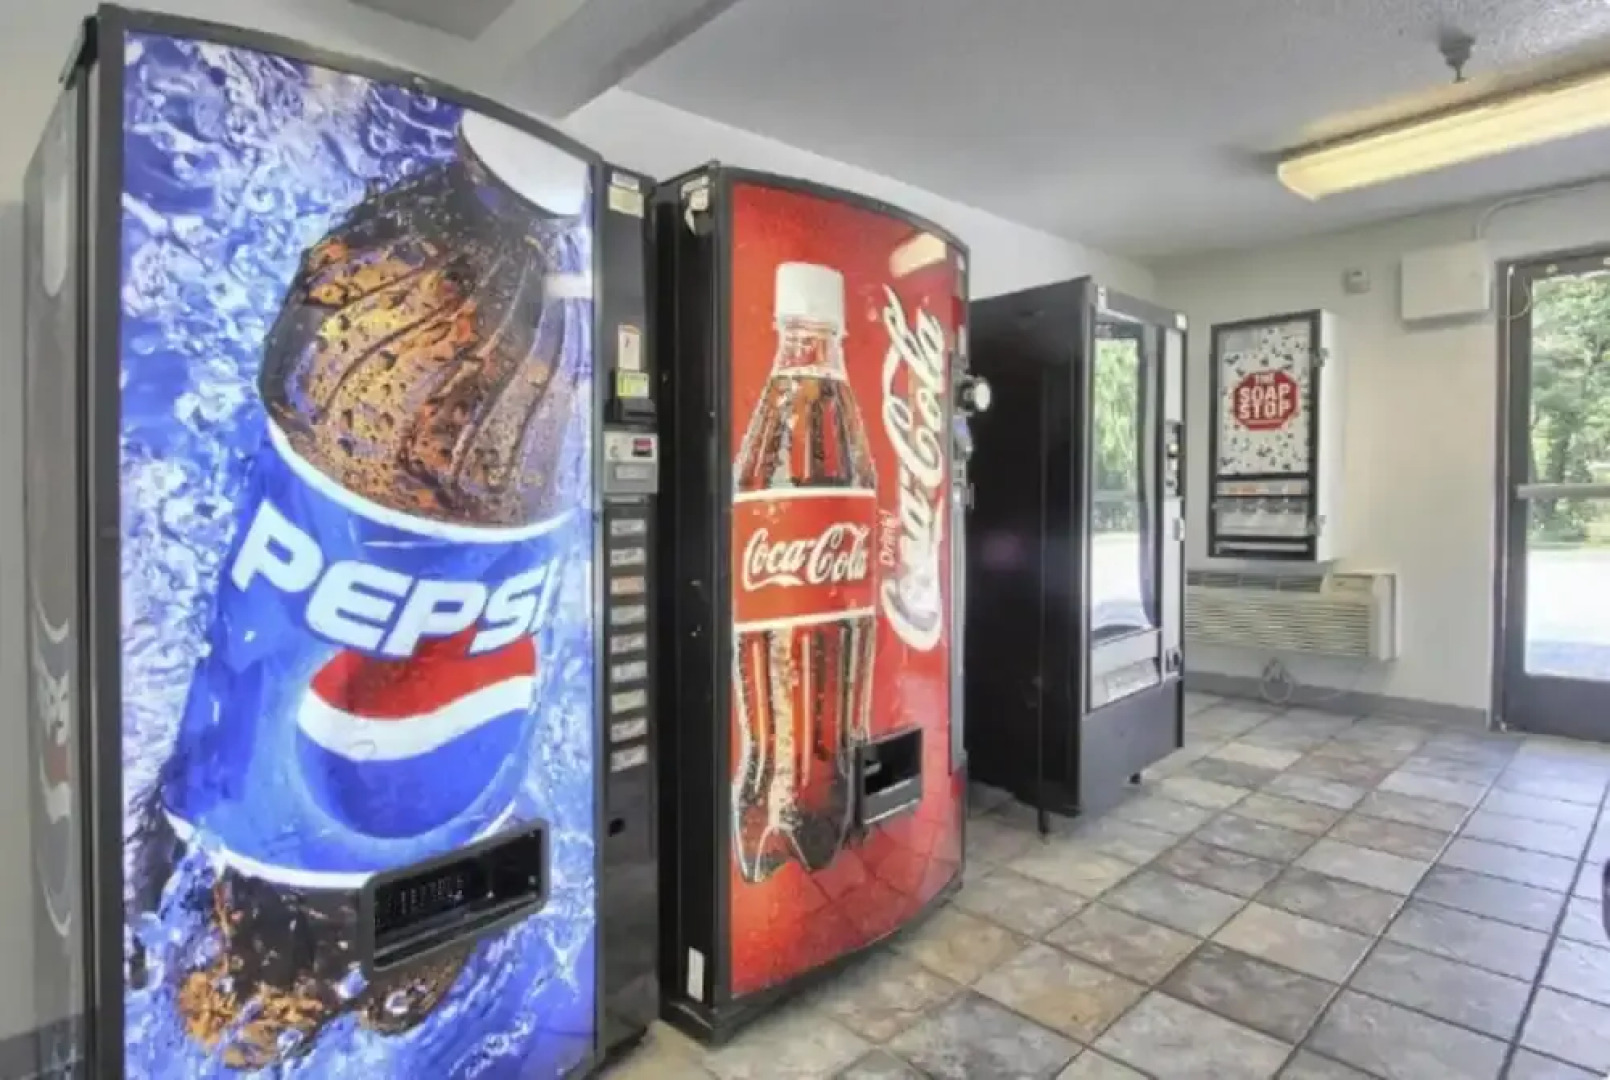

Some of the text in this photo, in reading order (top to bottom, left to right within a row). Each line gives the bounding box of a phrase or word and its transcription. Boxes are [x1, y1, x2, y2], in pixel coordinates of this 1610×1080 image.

[1239, 383, 1290, 403] SOAP
[1239, 400, 1290, 419] STOP
[881, 283, 945, 651] Ca-Cola
[231, 500, 558, 657] PEPSI
[742, 523, 870, 592] Coca-Cola
